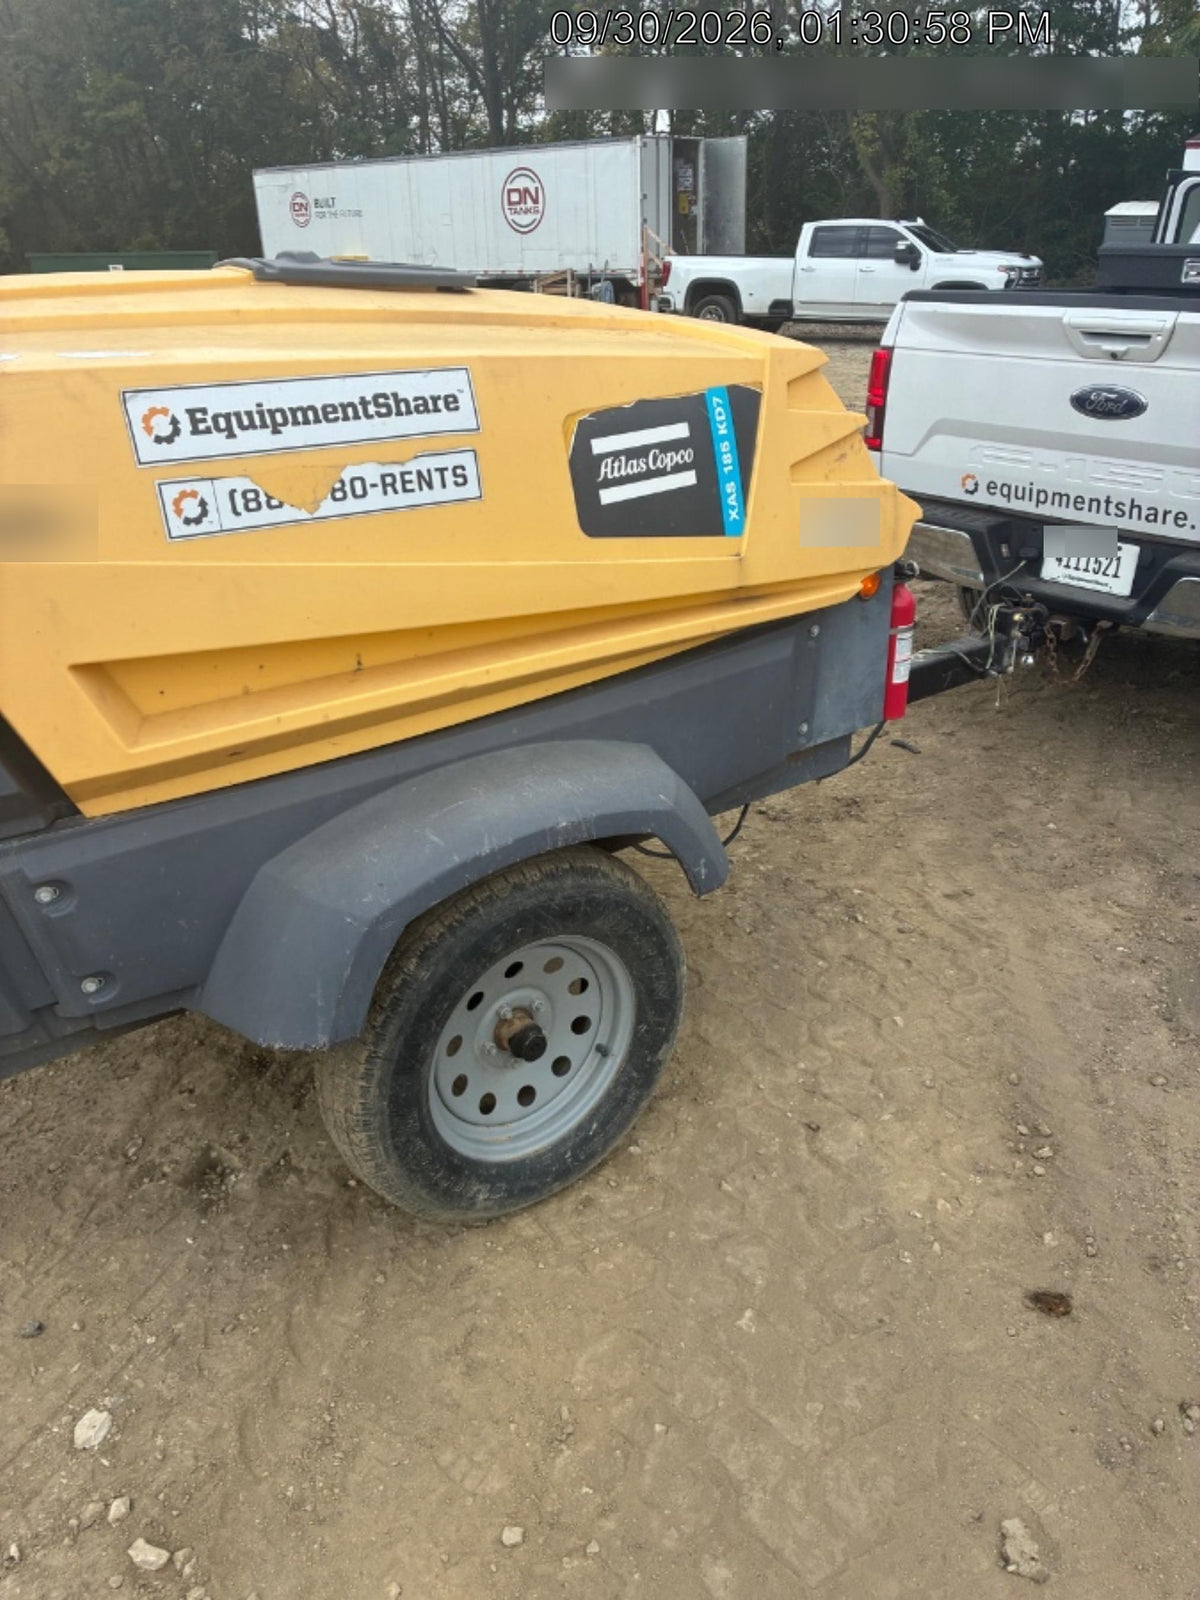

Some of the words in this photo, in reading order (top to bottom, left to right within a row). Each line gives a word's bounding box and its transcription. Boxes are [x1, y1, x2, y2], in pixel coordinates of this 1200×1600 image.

[712, 396, 728, 435] KD7
[1084, 391, 1129, 413] Ford
[597, 455, 647, 482] Atlas
[648, 447, 694, 471] Copco
[719, 440, 733, 474] 185
[725, 481, 740, 521] XAS
